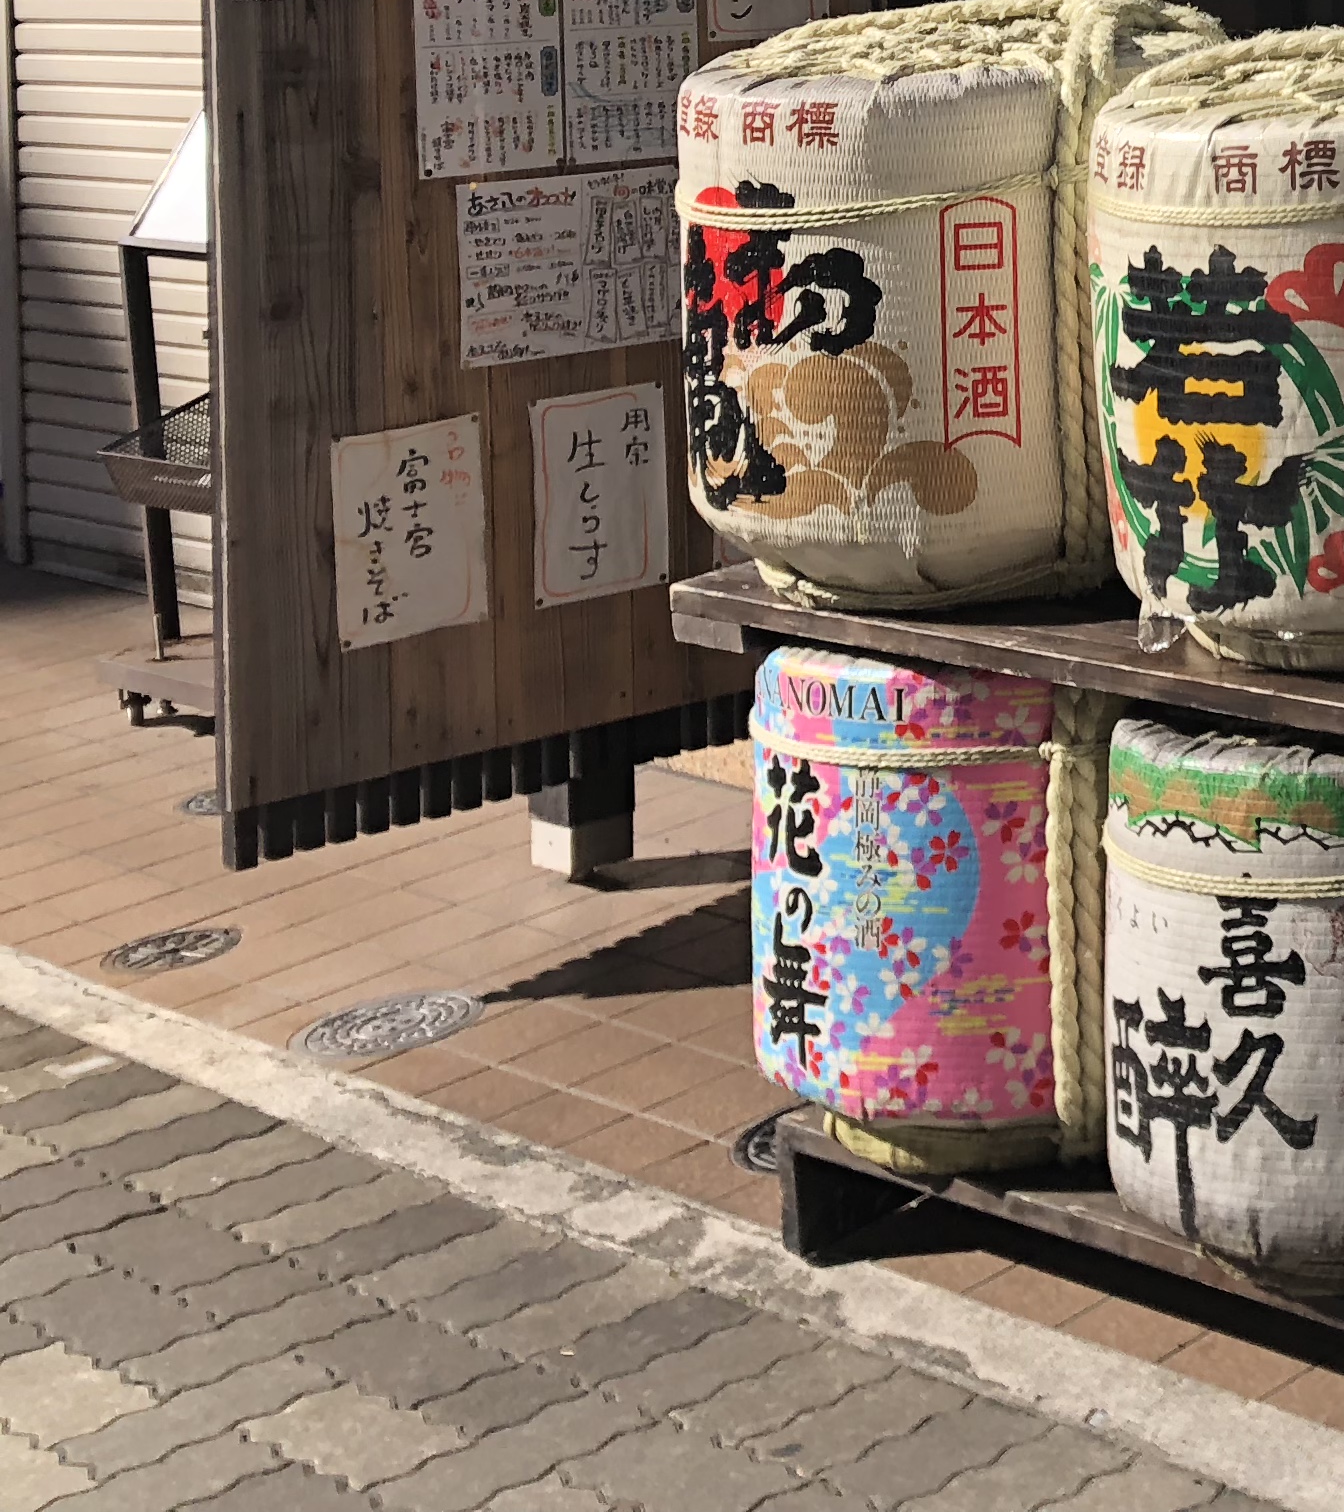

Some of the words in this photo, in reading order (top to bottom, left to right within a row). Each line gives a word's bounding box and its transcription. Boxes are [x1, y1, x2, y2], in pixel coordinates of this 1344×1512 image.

[952, 220, 1009, 420] 日本酒
[397, 448, 434, 558] 富士宮
[1110, 244, 1308, 612] 若竹
[356, 495, 408, 626] 焼きそば
[762, 753, 828, 1070] 花の舞
